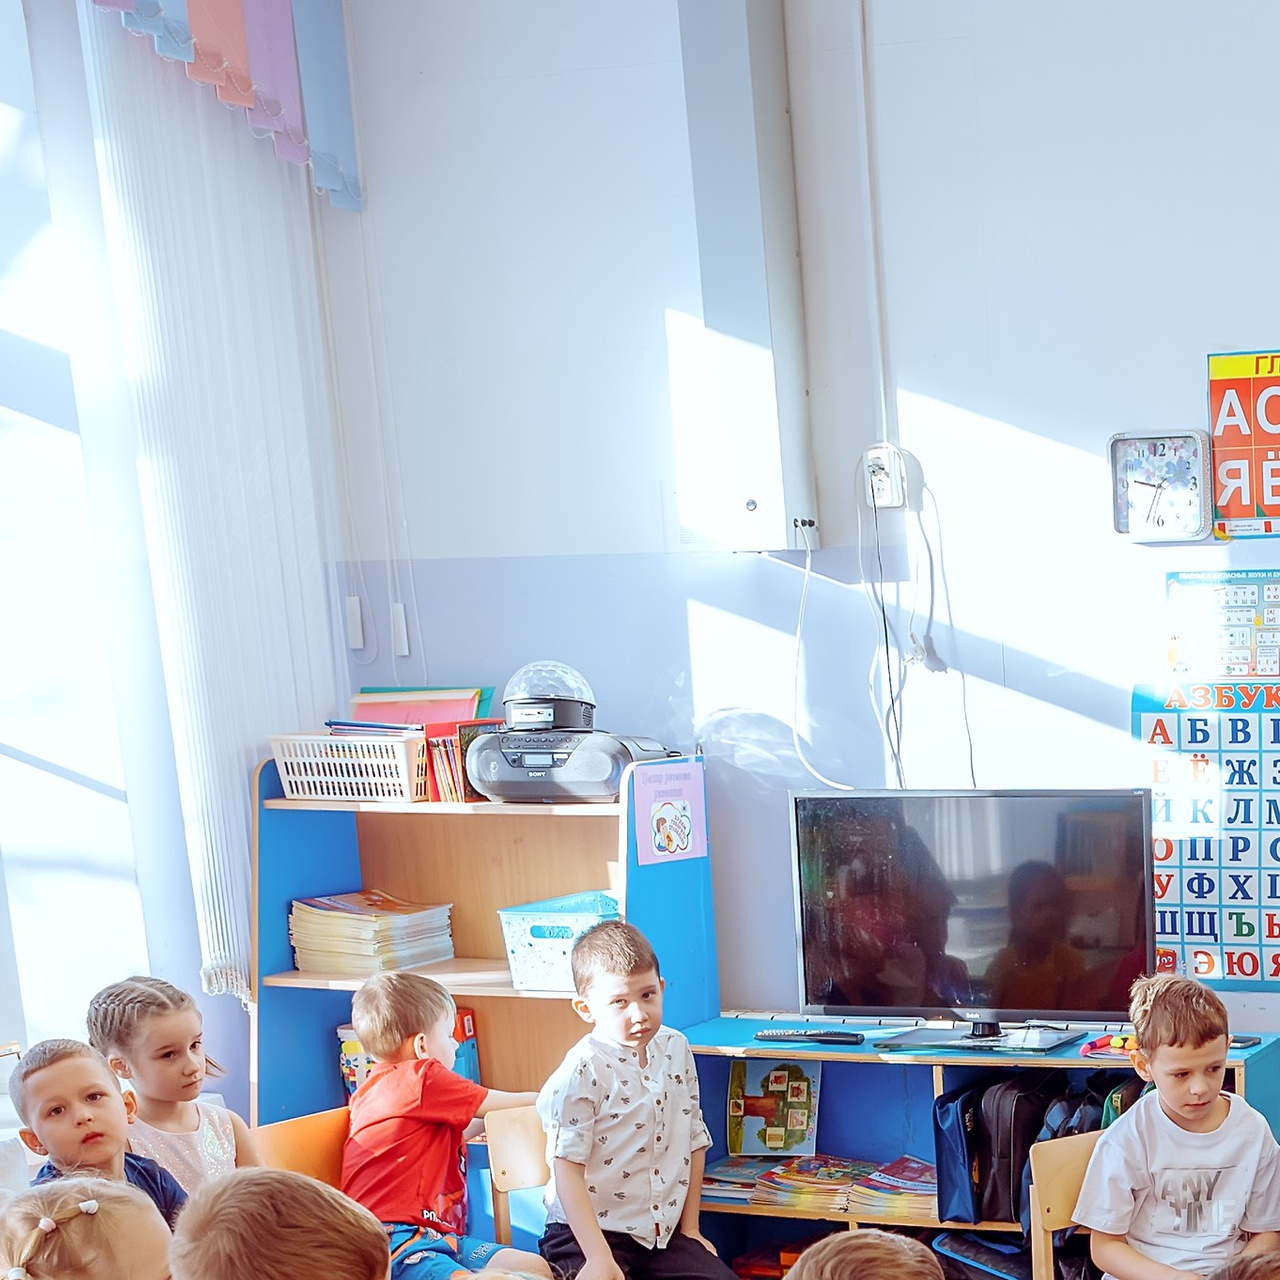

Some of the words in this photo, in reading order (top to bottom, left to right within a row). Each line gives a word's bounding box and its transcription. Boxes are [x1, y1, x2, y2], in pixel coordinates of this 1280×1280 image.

[1214, 389, 1251, 436] А
[1217, 460, 1250, 506] Я
[1148, 719, 1173, 745] А
[1187, 719, 1210, 745] Б
[1228, 719, 1251, 744] В
[1189, 754, 1210, 784] Ё
[1225, 759, 1258, 785] Ж
[1190, 800, 1213, 824] К
[1227, 799, 1254, 824] Л
[1154, 838, 1173, 862] О
[1187, 838, 1213, 862] П
[1228, 836, 1251, 862] Р
[1155, 874, 1175, 900] У
[1186, 873, 1216, 899] Ф
[1228, 874, 1254, 900] Х
[1156, 911, 1179, 936] Ш
[1185, 911, 1218, 942] Щ
[1228, 912, 1256, 937] Ъ
[1193, 950, 1215, 975] Э
[1226, 951, 1259, 977] Ю
[1161, 1171, 1222, 1202] ANY
